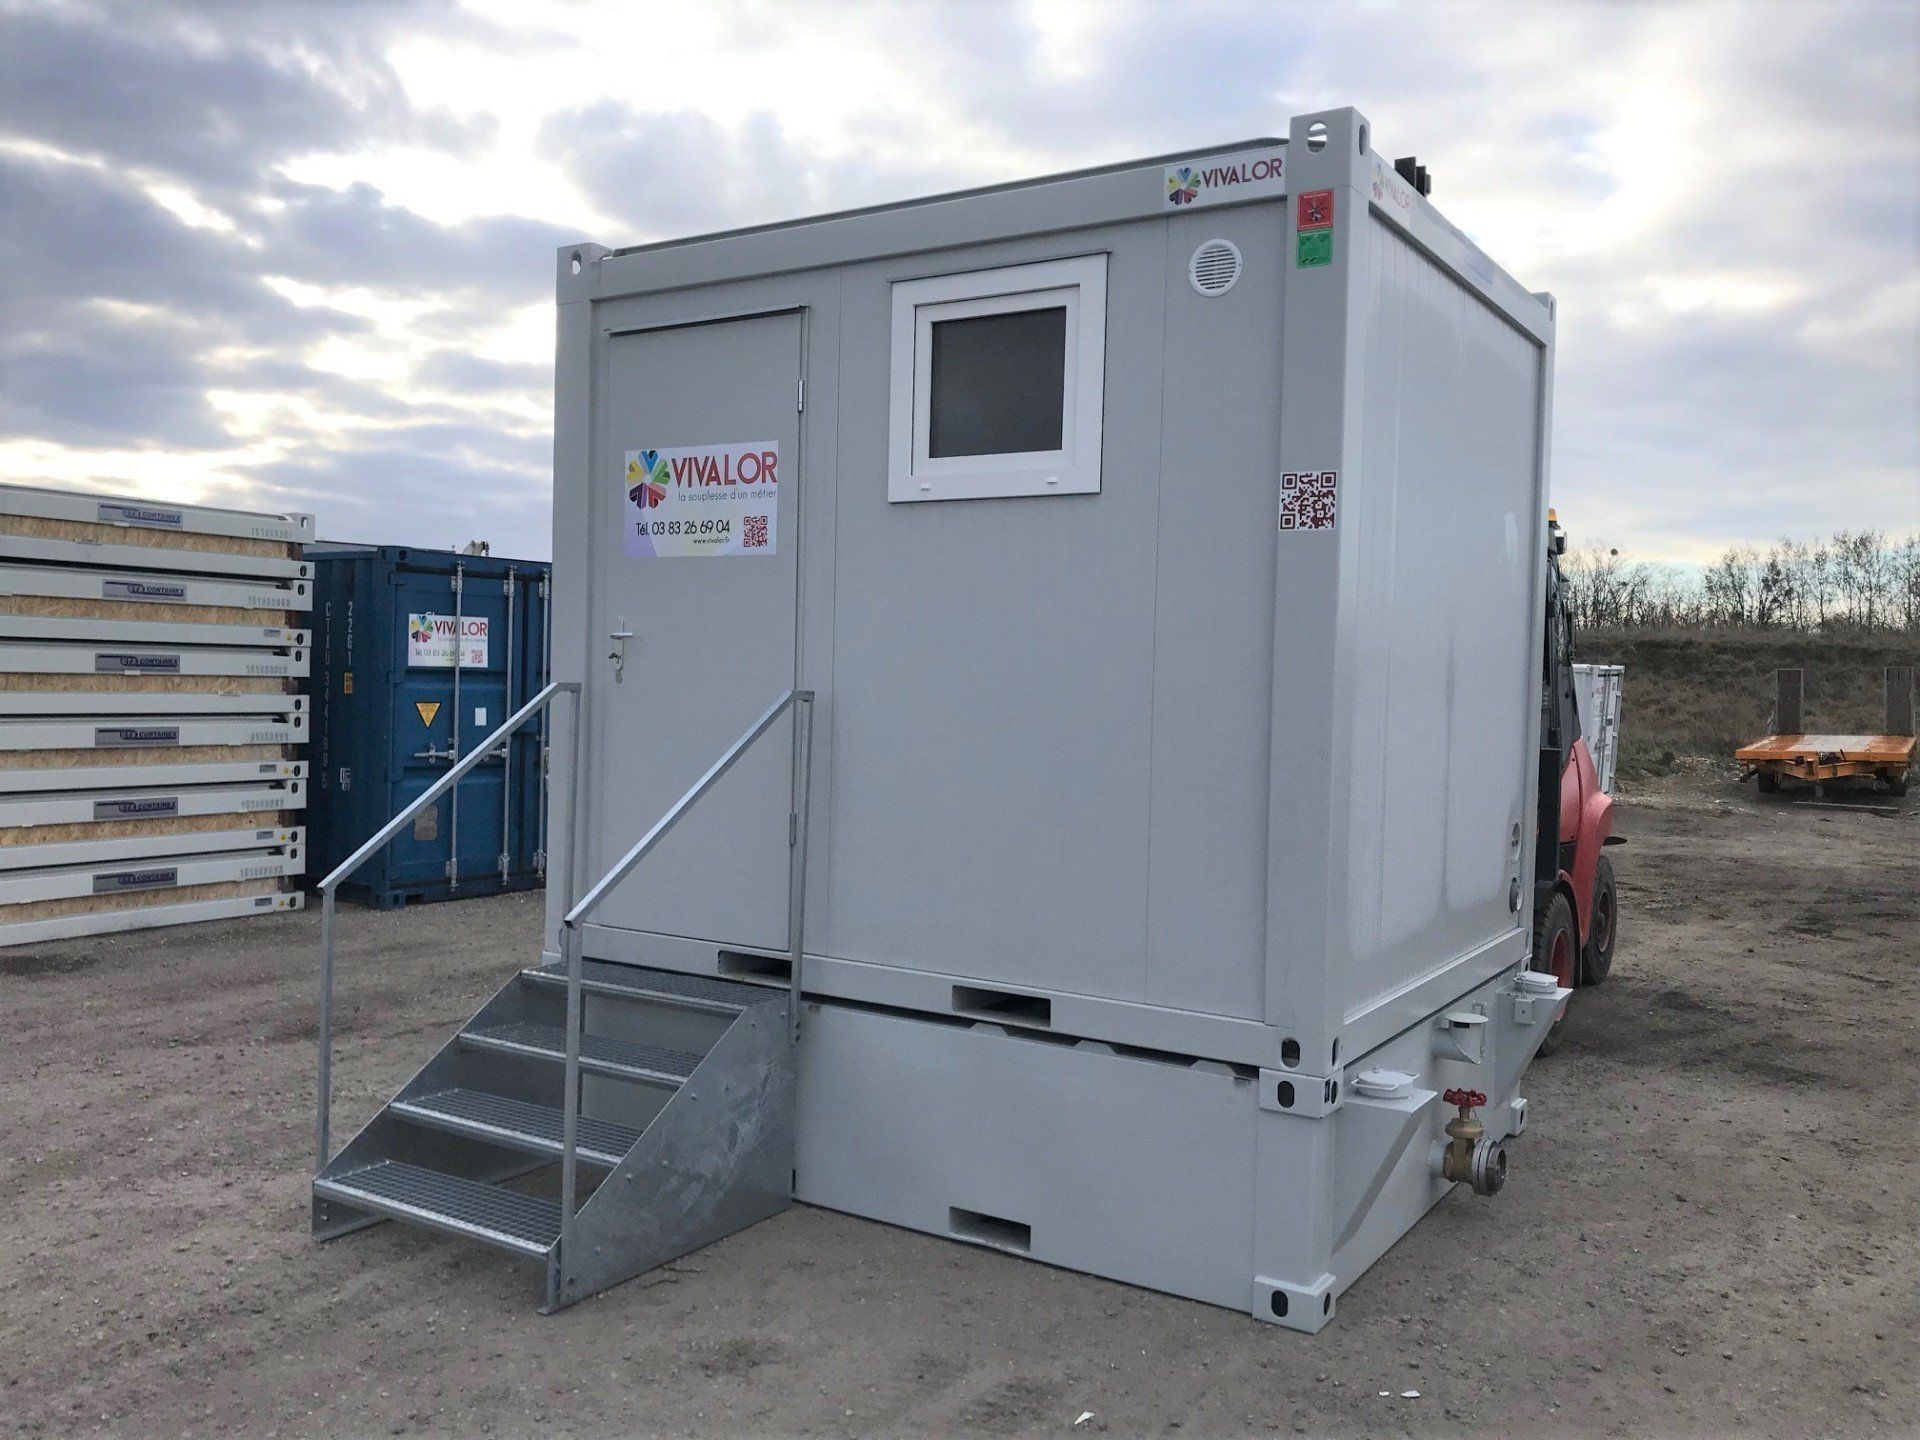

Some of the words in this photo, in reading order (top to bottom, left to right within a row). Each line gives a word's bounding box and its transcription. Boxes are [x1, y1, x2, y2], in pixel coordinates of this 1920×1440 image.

[1201, 157, 1283, 189] VIVALOR
[671, 451, 778, 488] VIVALOR
[678, 490, 686, 502] la
[688, 490, 727, 503] souplesse
[730, 489, 748, 500] d'un
[750, 488, 777, 499] métier
[652, 521, 665, 535] 03
[668, 521, 681, 535] 83
[684, 520, 697, 534] 26
[699, 520, 714, 534] 69
[716, 519, 730, 533] 04
[434, 620, 488, 636] VIVLOR
